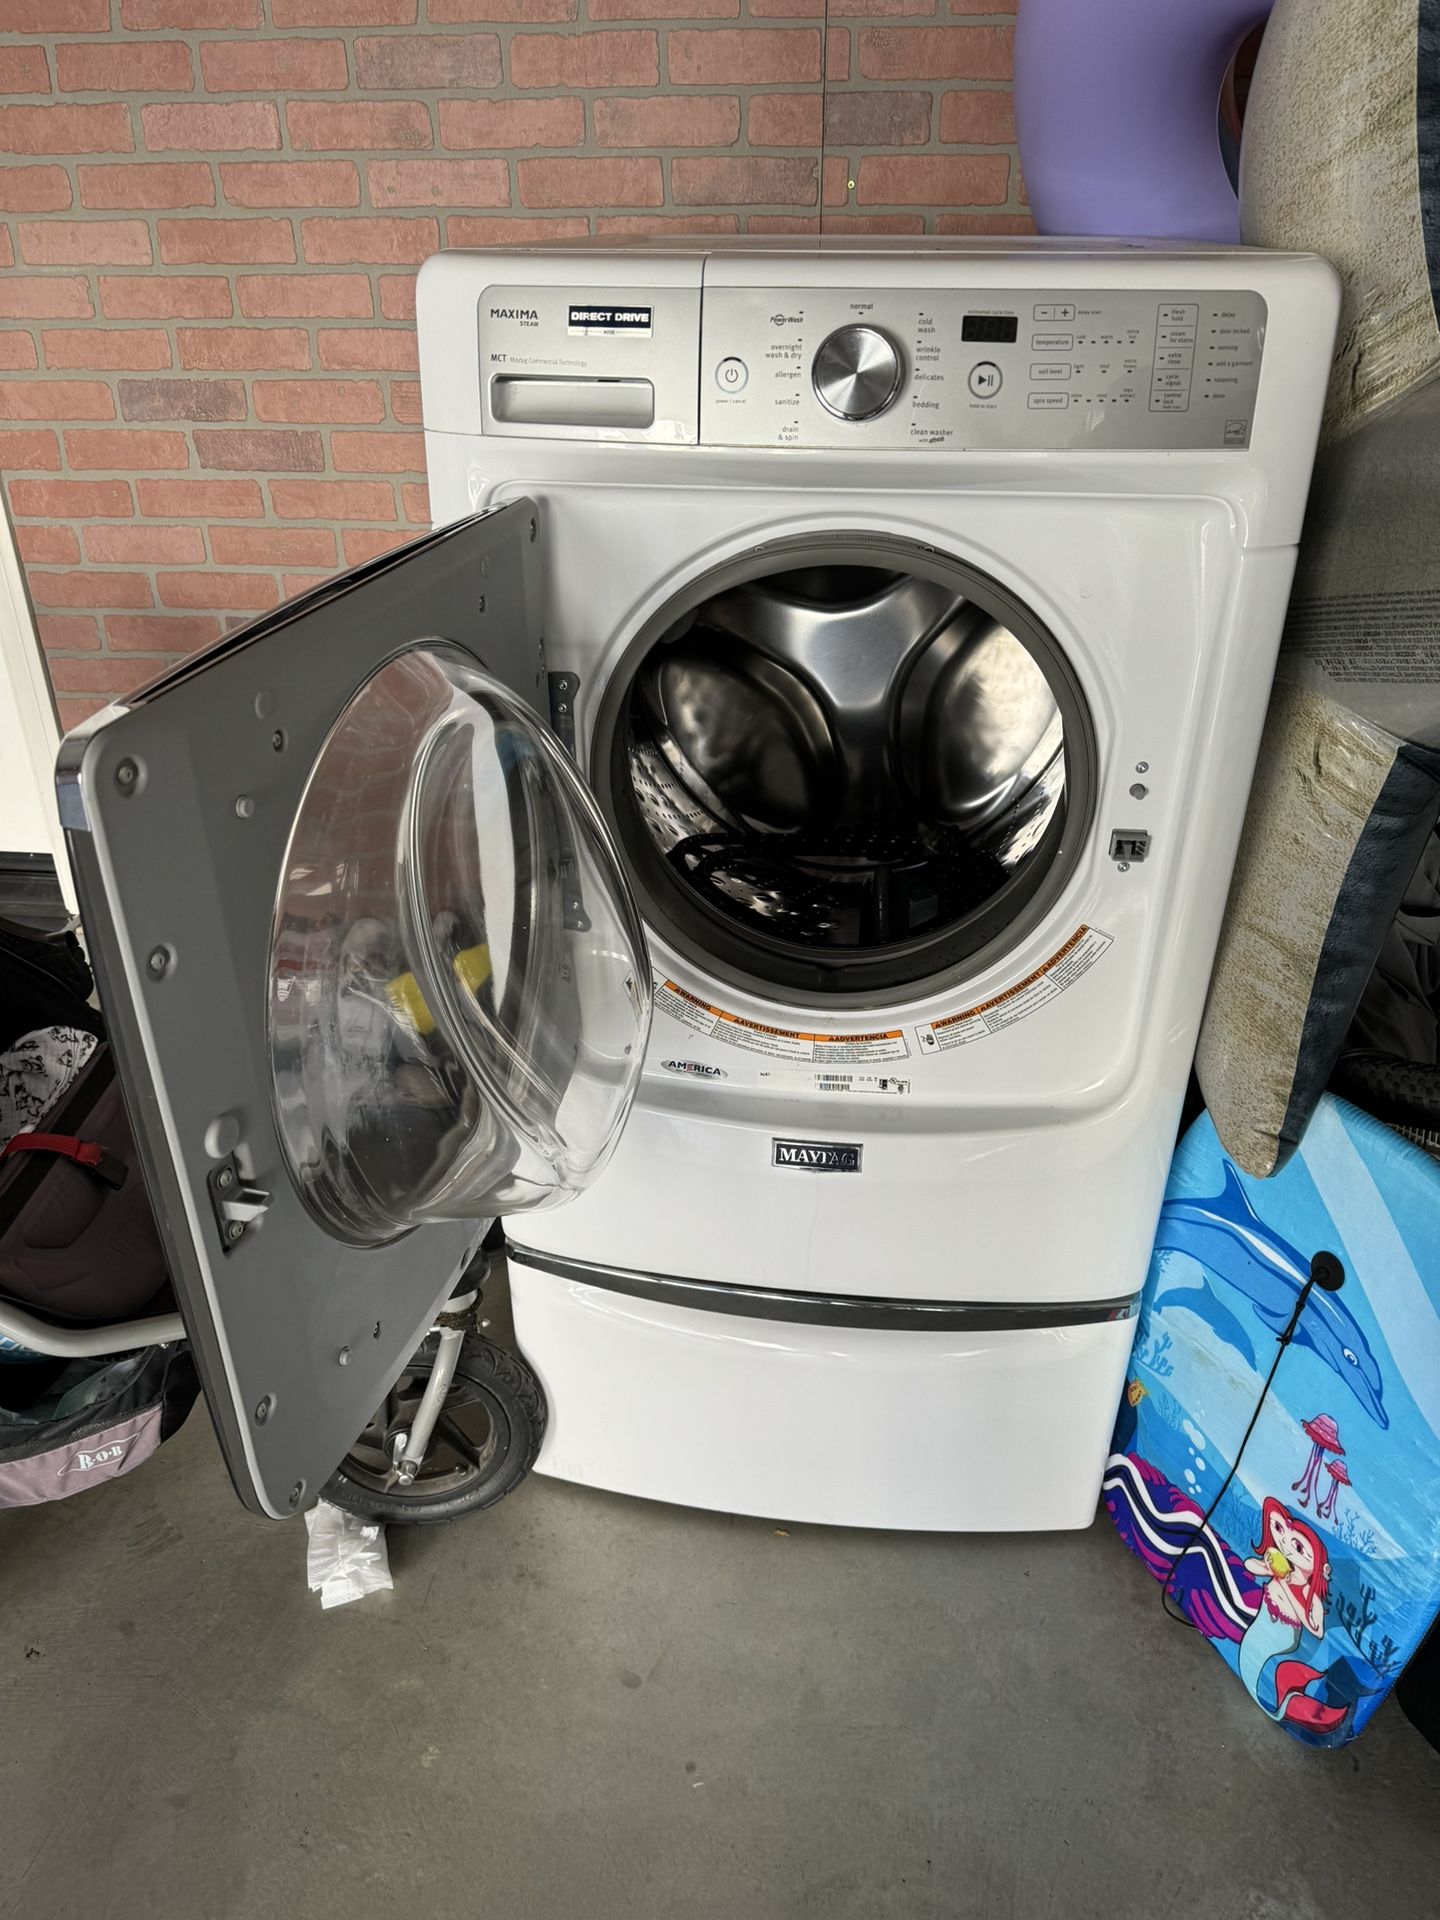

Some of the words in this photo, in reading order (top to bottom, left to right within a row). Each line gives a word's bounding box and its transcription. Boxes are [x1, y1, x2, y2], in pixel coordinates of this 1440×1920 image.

[490, 308, 538, 320] MAXIMA
[570, 311, 613, 322] DIRECT
[615, 312, 650, 323] DRIVE
[490, 353, 507, 363] MCT
[790, 352, 802, 360] dry
[774, 371, 801, 379] allergen
[912, 401, 940, 409] bedding
[1046, 925, 1089, 971] ADVERTENCIA
[985, 970, 1042, 1010] AVERTISSEMENT
[679, 988, 711, 1011] WARNING
[941, 1008, 977, 1028] WARNING
[739, 1018, 800, 1039] AVERTISSEMENT
[834, 1033, 889, 1042] ADVERTENCIA
[668, 1060, 721, 1076] AMERICA
[779, 1147, 855, 1166] MAYTAG
